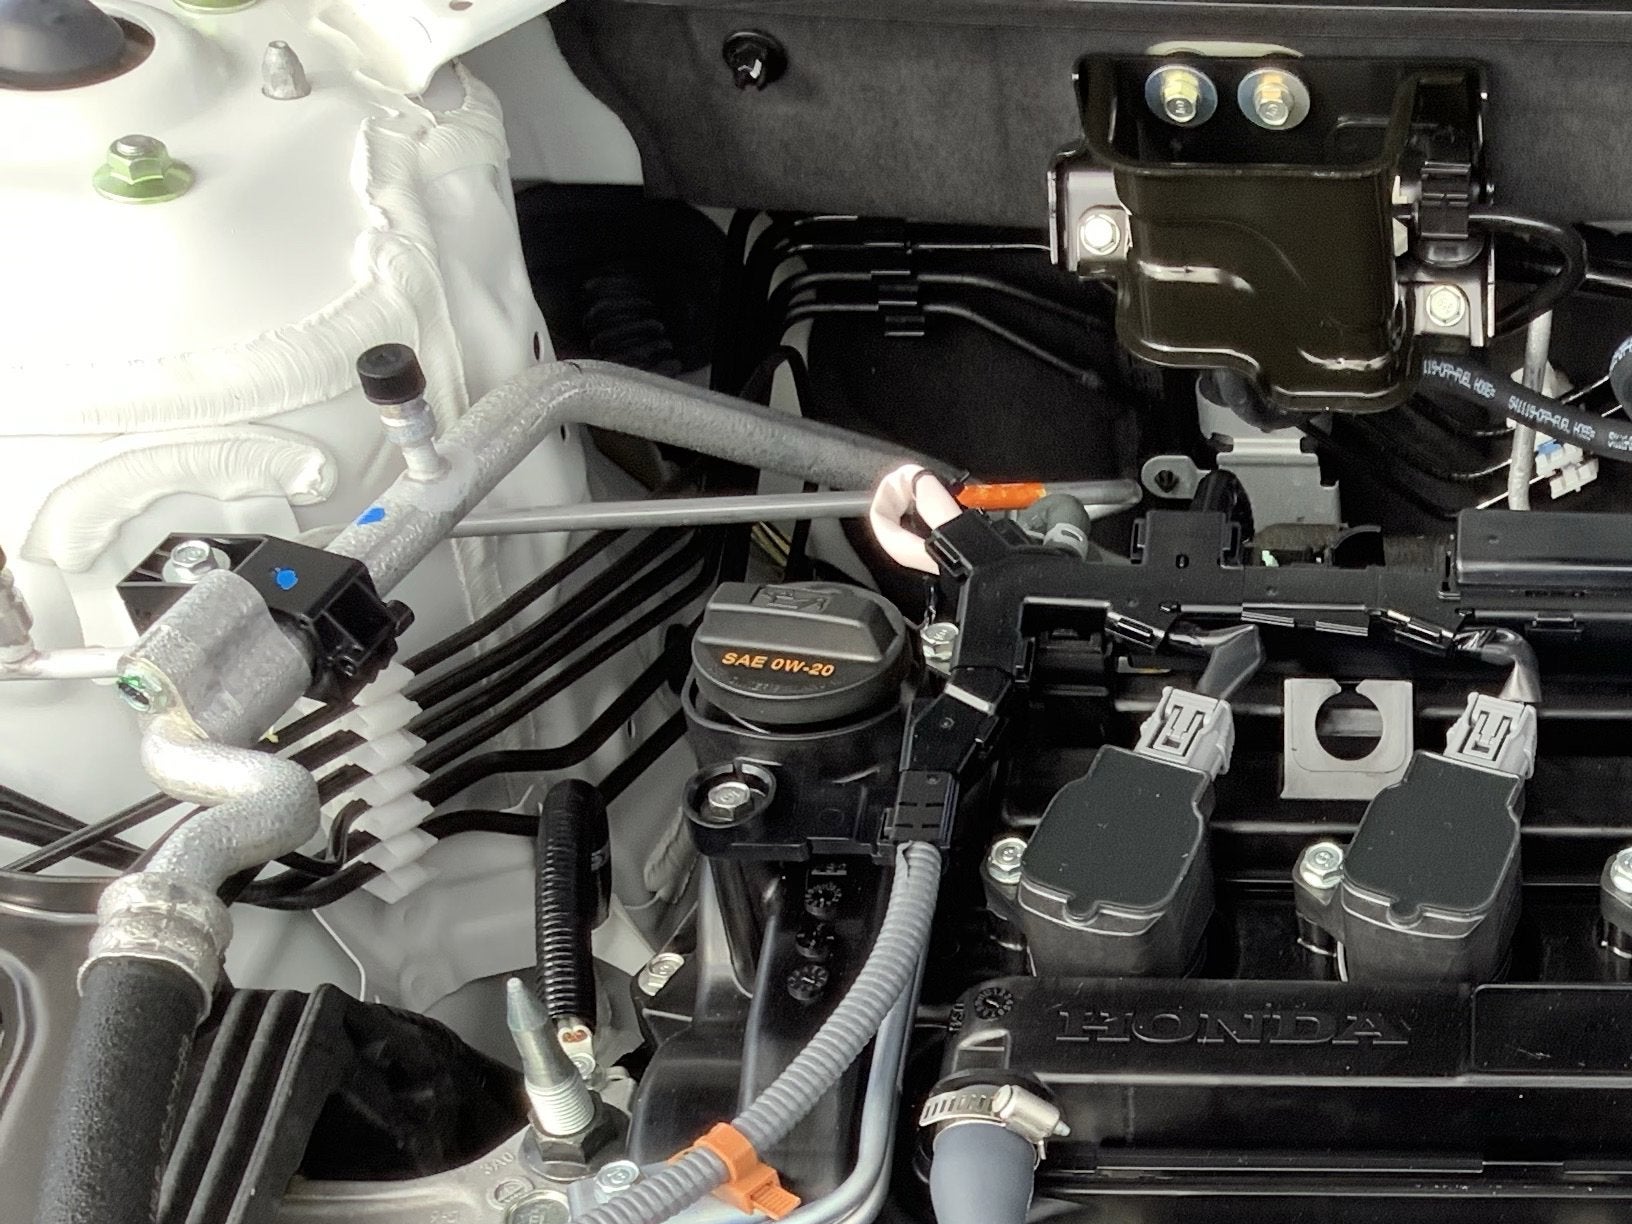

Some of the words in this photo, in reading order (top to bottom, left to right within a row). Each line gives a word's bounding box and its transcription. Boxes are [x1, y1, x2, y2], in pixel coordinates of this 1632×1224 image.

[721, 652, 768, 669] SAE
[771, 658, 835, 677] 0W-20
[1056, 1011, 1408, 1044] HONDA
